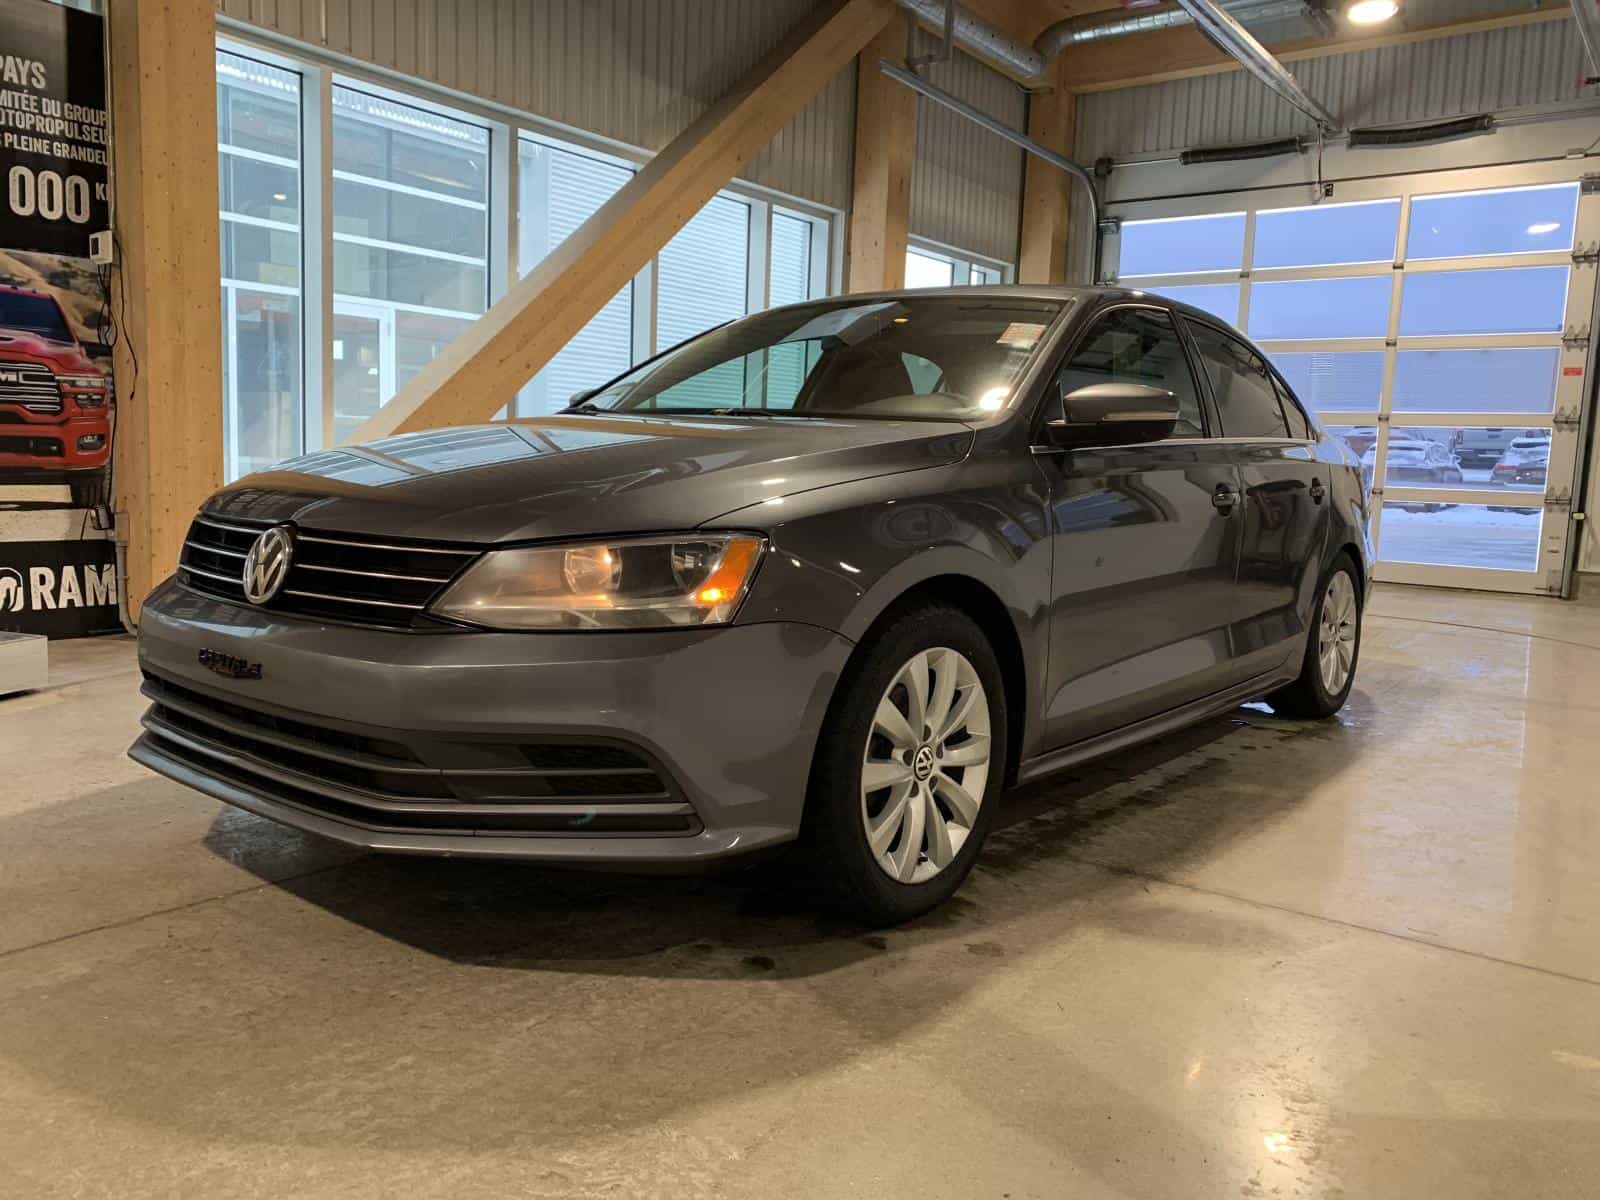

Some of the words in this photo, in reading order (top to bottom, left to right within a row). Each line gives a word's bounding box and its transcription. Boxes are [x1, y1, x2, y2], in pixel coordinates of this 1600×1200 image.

[41, 98, 61, 117] DU
[4, 132, 51, 155] PLEINE
[9, 165, 91, 224] 000
[95, 182, 109, 201] K
[29, 564, 118, 610] RAM
